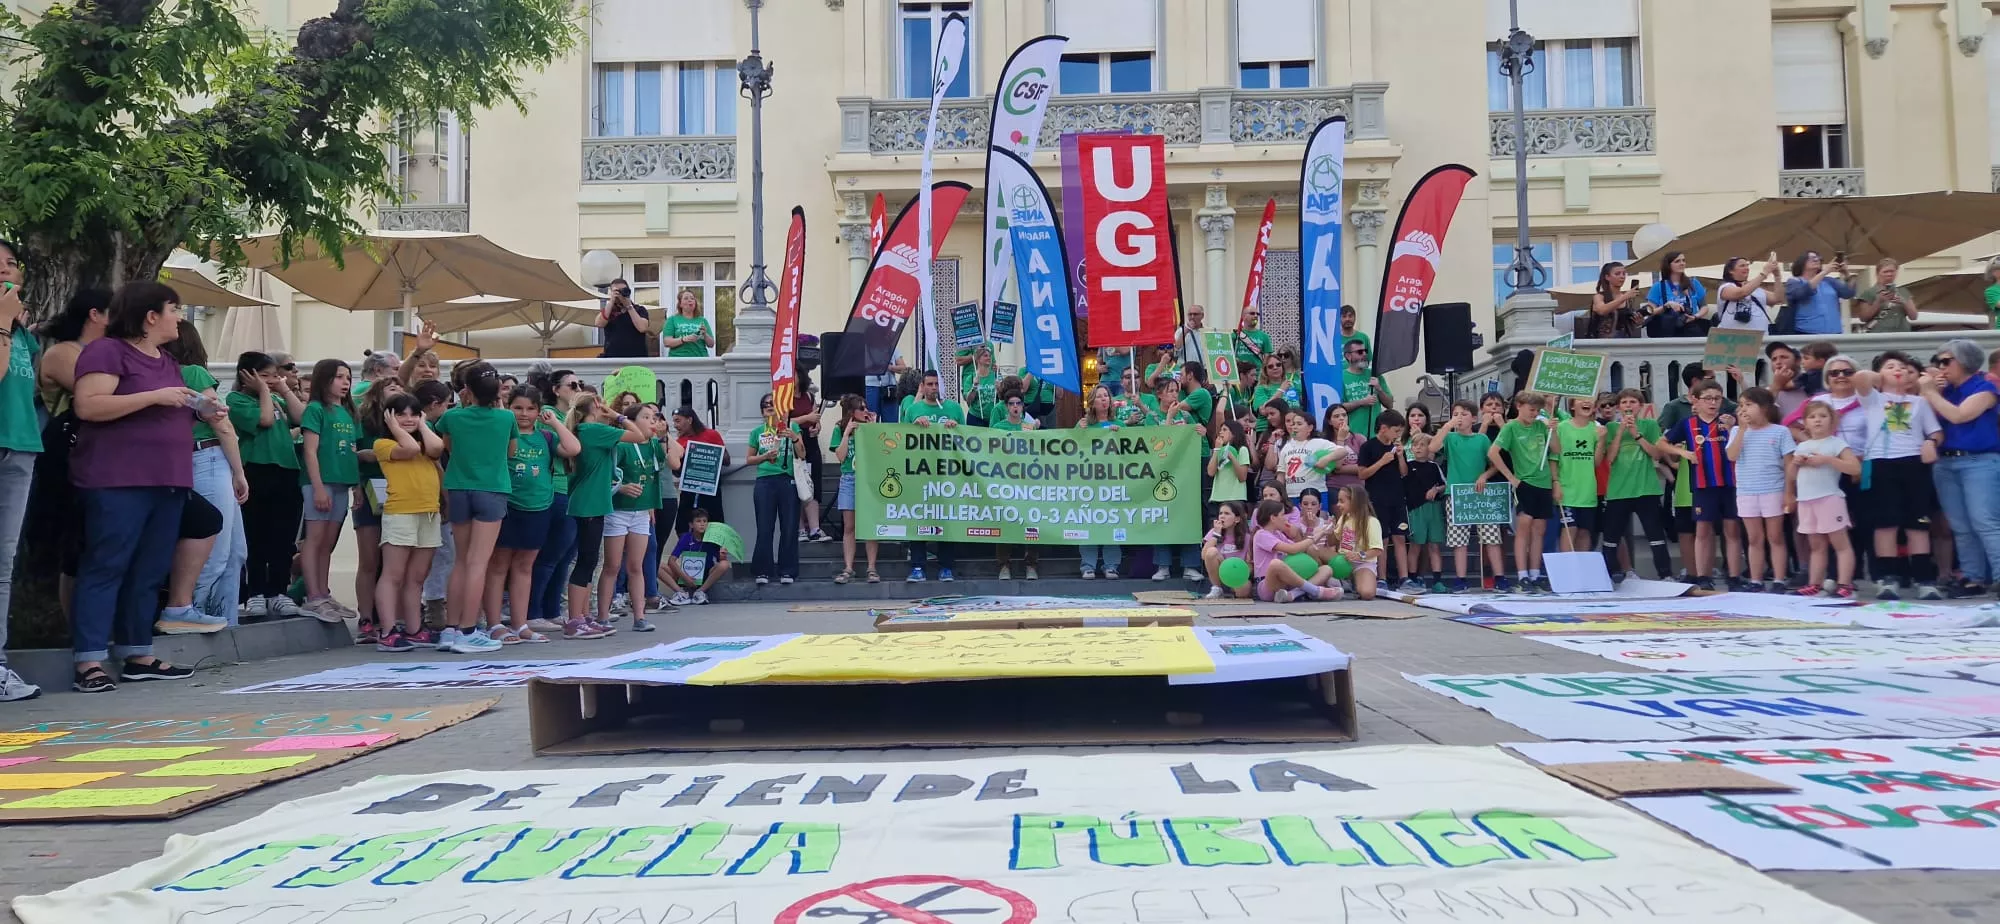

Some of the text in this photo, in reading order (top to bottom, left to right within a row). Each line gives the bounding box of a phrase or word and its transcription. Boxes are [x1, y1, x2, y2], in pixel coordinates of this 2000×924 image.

[1093, 145, 1157, 332] UGT
[1395, 284, 1407, 293] La
[1398, 275, 1422, 286] Arag
[870, 293, 905, 315] La Rioja
[875, 285, 908, 305] Aragón
[861, 303, 904, 332] CGT
[905, 432, 1150, 459] DINERO PÚBLICO, PARA
[904, 457, 1155, 481] LA EDUCACIÓN PÚBLICA
[922, 481, 1131, 503] ¡NO AL CONCIERTO DEL
[886, 504, 1170, 526] BACHILLERATO, 0-3 AÑOS Y FP!
[1428, 674, 1932, 698] PÚBLICA
[1572, 697, 1867, 717] VAN
[353, 760, 1379, 814] DEFIENDE LA
[153, 808, 1617, 892] ESCUELA PÚBLICA
